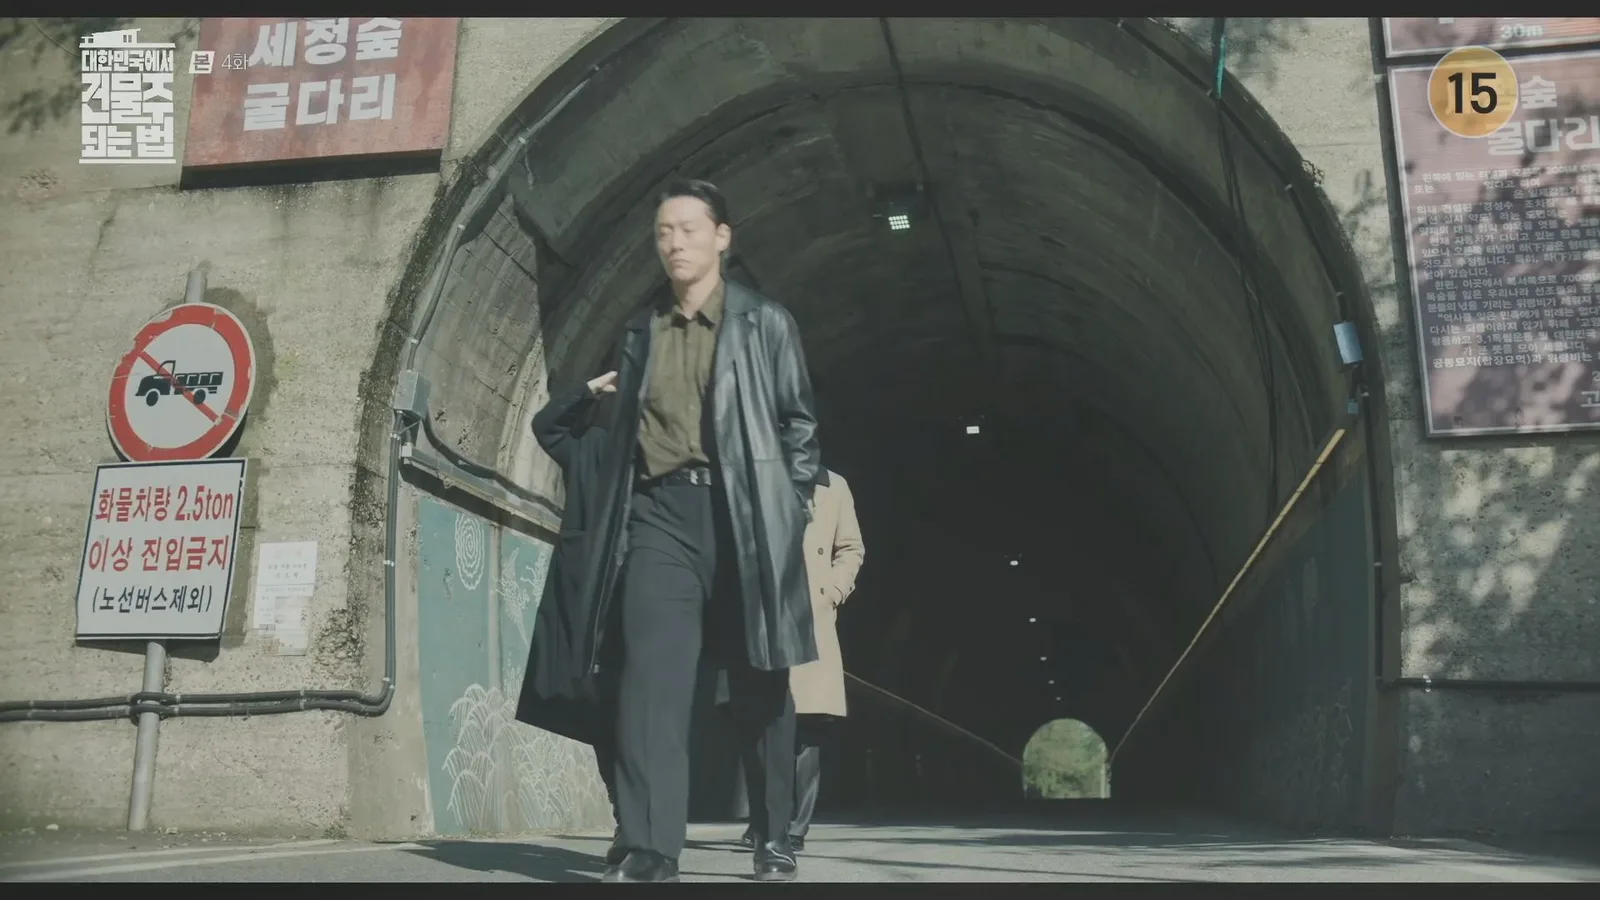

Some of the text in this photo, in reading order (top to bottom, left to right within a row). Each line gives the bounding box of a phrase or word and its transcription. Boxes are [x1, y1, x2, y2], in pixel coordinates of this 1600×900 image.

[249, 17, 403, 68] 세정숲
[244, 74, 396, 132] 굴다리
[1484, 179, 1514, 189] 있다고
[1453, 233, 1495, 244] 자동차가
[1498, 232, 1530, 242] 다니고
[1534, 230, 1555, 240] 있는
[1420, 246, 1450, 257] 있으나
[1485, 243, 1515, 254] 터널인
[1422, 257, 1452, 268] 것으로
[1448, 266, 1492, 278] 있습니다.
[1462, 277, 1503, 289] 이곳에서
[1487, 287, 1529, 298] 우리나라
[1482, 298, 1512, 309] 기리는
[1543, 307, 1574, 318] 미래는
[1429, 323, 1460, 334] 다시는
[1552, 328, 1596, 340] 대한민국
[1516, 342, 1538, 353] 모아
[1546, 351, 1593, 363] 위령비는
[95, 485, 233, 522] 화물차량 2.5ton
[88, 534, 229, 572] 이상 진입금지
[91, 584, 213, 614] (노선버스제외)
